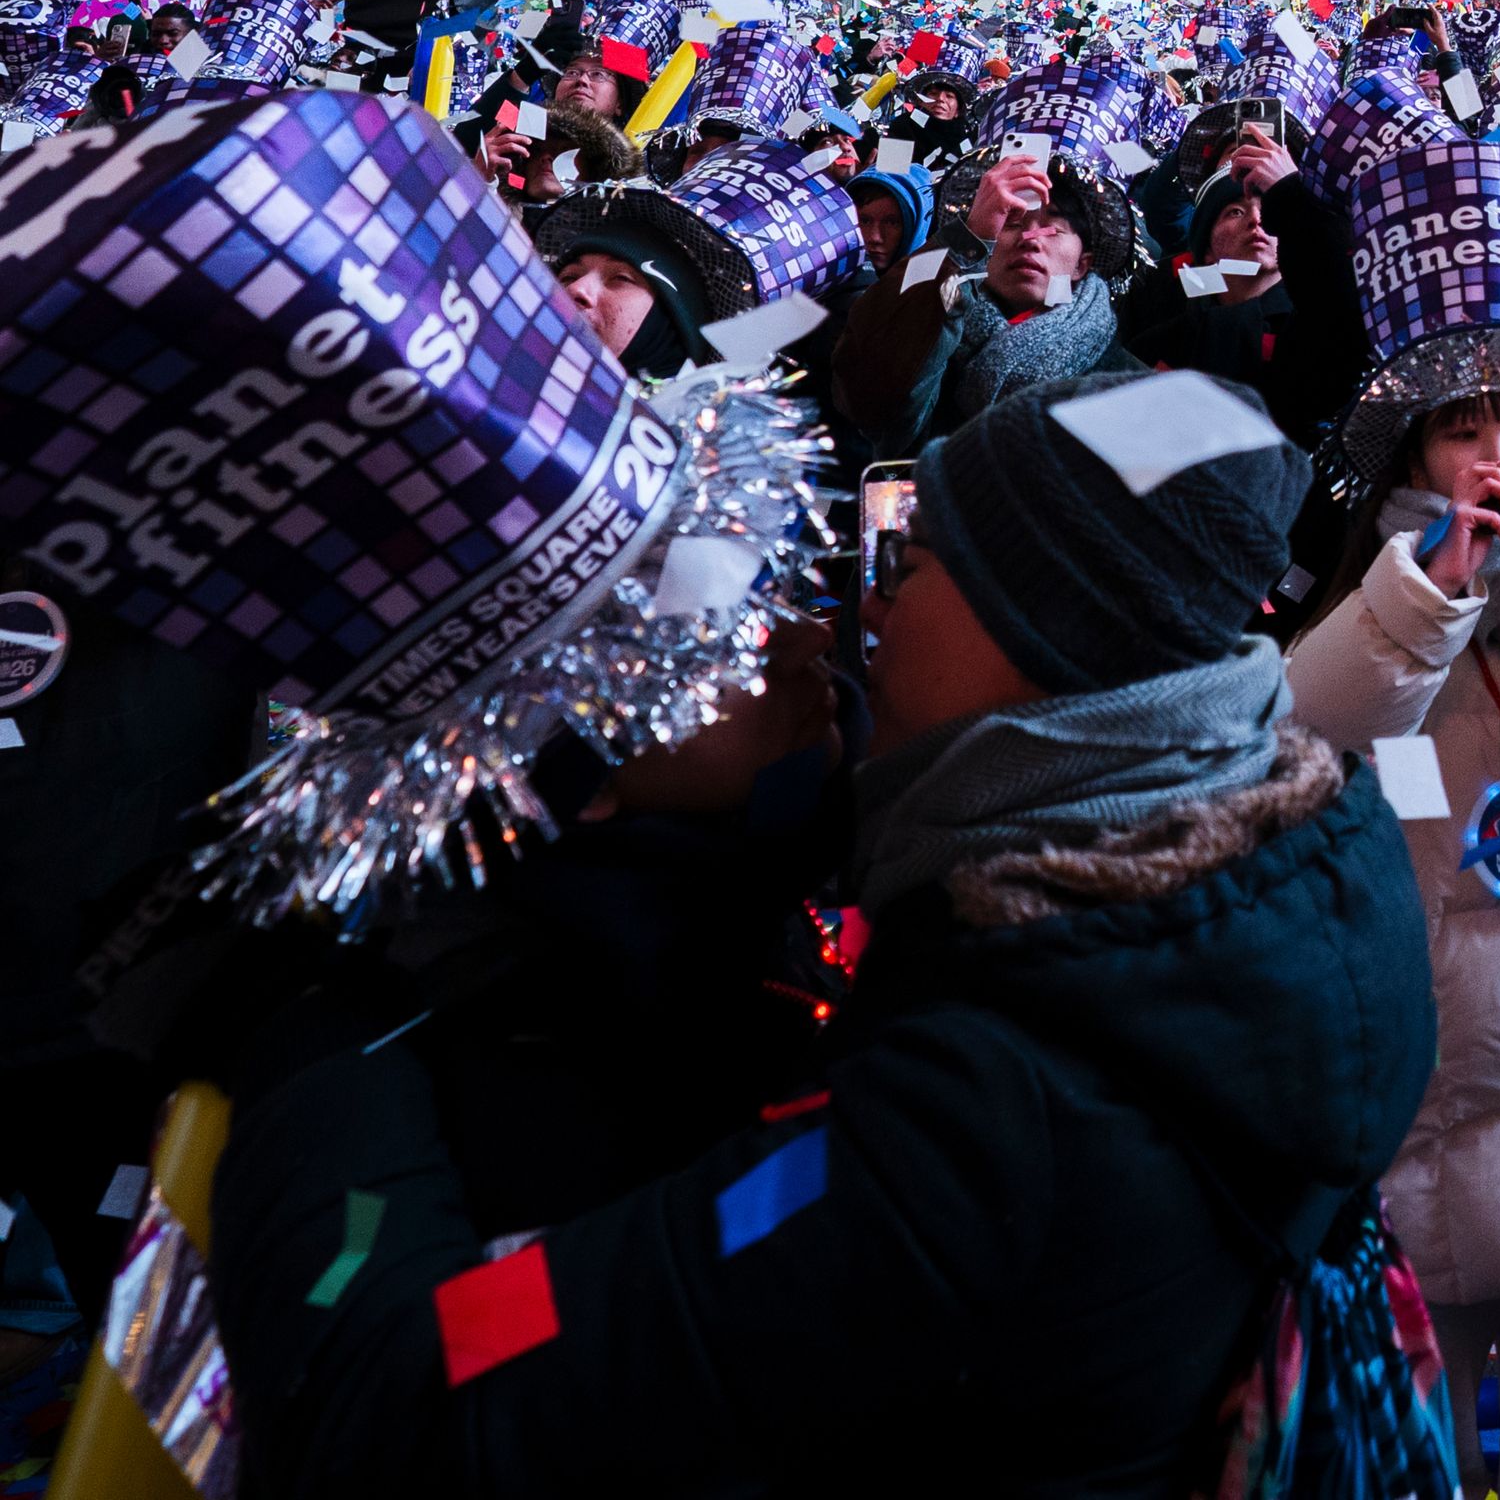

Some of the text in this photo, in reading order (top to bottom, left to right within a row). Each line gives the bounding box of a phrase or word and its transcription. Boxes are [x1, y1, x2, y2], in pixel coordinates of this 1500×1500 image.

[233, 6, 308, 57] plane
[40, 71, 91, 95] anet
[1228, 55, 1316, 90] planet
[1006, 91, 1126, 143] planet
[1350, 98, 1432, 177] plane
[703, 157, 812, 208] anet
[25, 257, 403, 596] planet
[126, 282, 481, 588] fitness
[364, 486, 620, 700] TIMES SQUARE
[449, 570, 582, 686] YEAR'S
[577, 506, 638, 581] EVE
